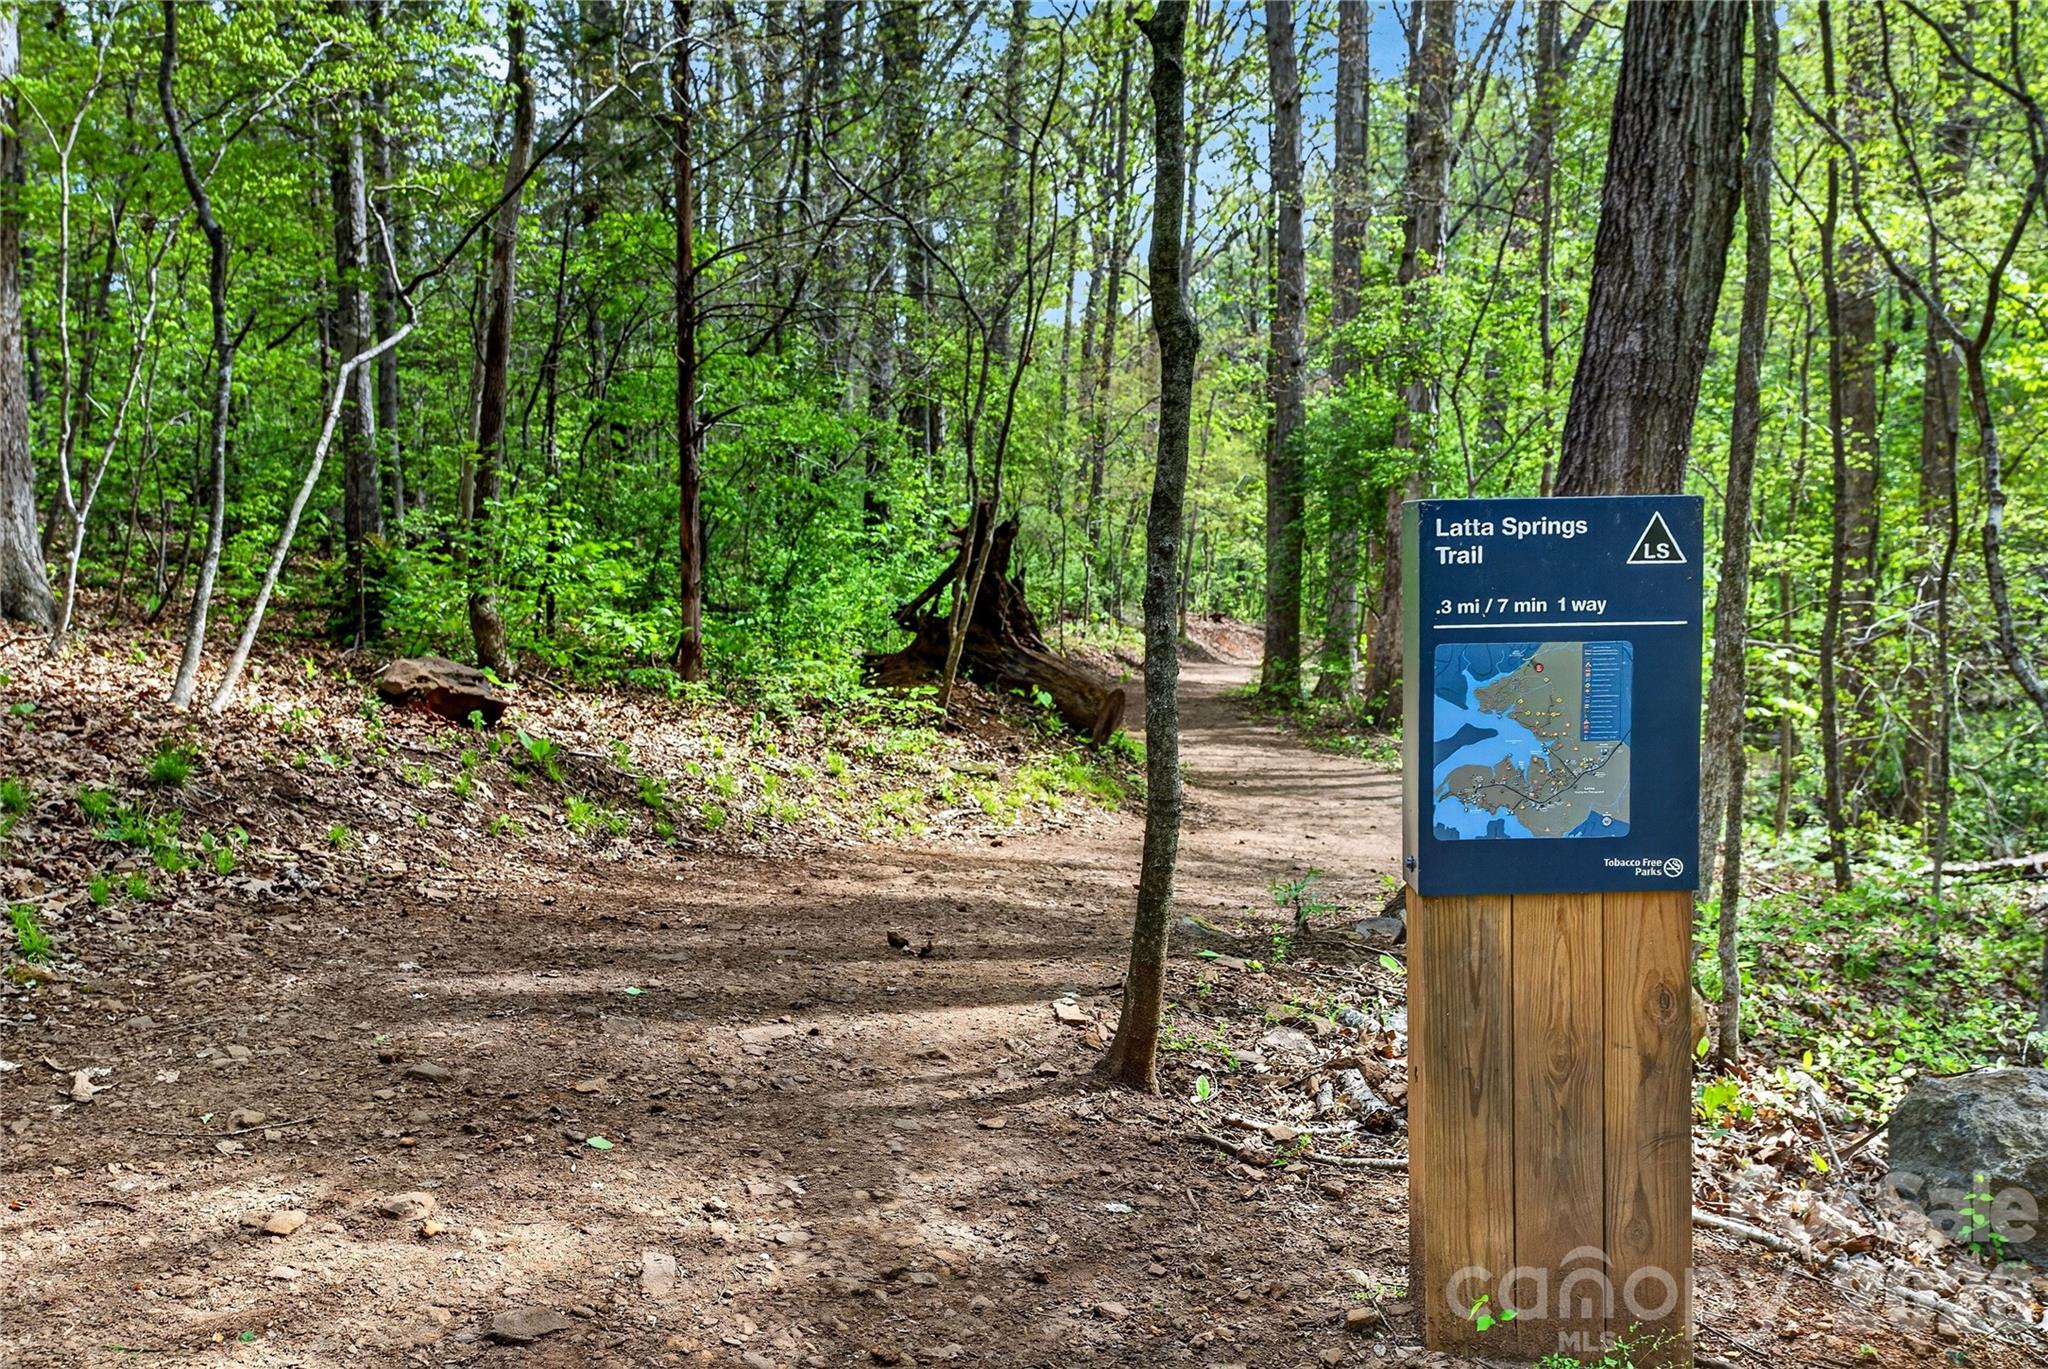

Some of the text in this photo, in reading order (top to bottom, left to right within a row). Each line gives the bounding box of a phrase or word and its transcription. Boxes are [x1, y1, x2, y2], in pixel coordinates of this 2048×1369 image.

[1435, 516, 1588, 539] Latta Springs
[1435, 545, 1483, 565] Trail
[1643, 543, 1670, 560] LS
[1435, 597, 1607, 615] .3 mi / 7 min 1 way
[1603, 858, 1662, 867] Tobacco Free
[1635, 867, 1662, 876] Parks
